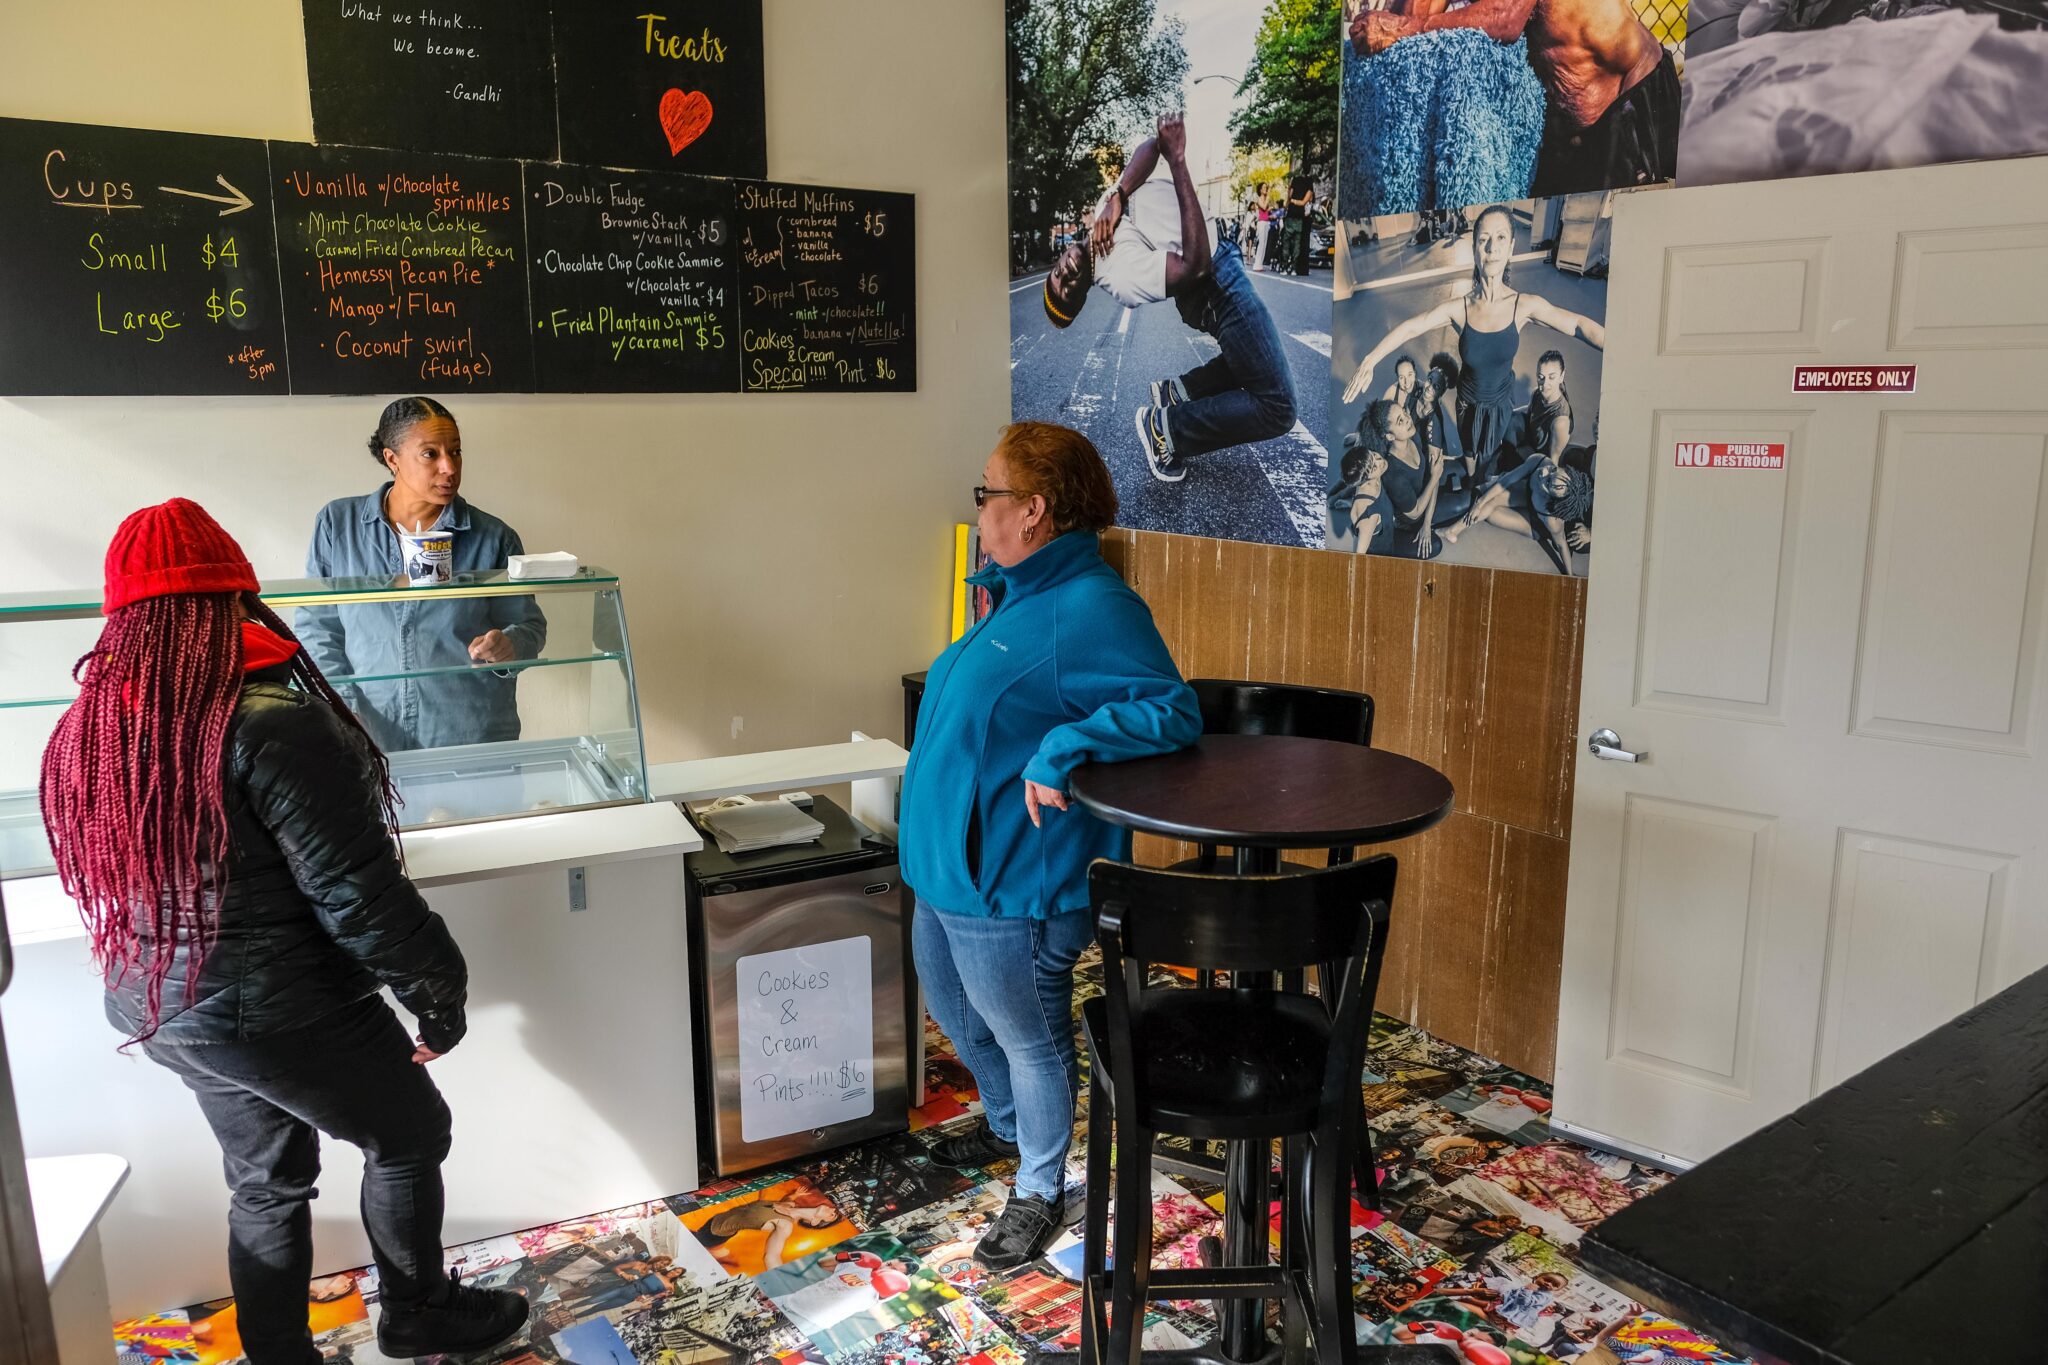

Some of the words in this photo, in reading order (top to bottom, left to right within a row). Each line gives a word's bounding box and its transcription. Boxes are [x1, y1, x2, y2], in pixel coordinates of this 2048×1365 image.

[341, 0, 381, 21] What
[393, 14, 414, 25] we
[427, 43, 480, 58] become.
[636, 13, 727, 63] Treats
[445, 83, 502, 102] -Gandhi
[44, 150, 134, 215] Cups
[294, 171, 368, 197] Vanilla
[434, 192, 510, 216] sprinkles
[544, 181, 603, 207] Double
[610, 183, 645, 214] Fudge
[744, 185, 797, 210] Stuffed
[804, 192, 855, 214] Muffins
[308, 211, 349, 236] Mint
[354, 212, 422, 233] Chocolate
[427, 211, 487, 233] Cookie
[601, 212, 650, 229] Brownie
[652, 212, 687, 230] Stack
[790, 216, 837, 226] cornbread
[864, 212, 886, 237] $5
[797, 230, 833, 239] banana
[798, 242, 829, 250] vanilla
[81, 233, 167, 271] Small
[202, 234, 239, 270] $4
[316, 239, 361, 259] Caramel
[365, 240, 397, 258] Fried
[401, 236, 465, 258] Cornbread
[471, 236, 514, 261] Pecan
[800, 252, 843, 261] chocolate
[544, 249, 604, 273] Chocolate
[608, 253, 632, 275] Chip
[636, 252, 674, 270] Cookie
[677, 252, 724, 268] Sammie
[319, 260, 394, 296] Hennessy
[400, 260, 447, 285] Pecan
[660, 295, 700, 307] vanilla
[753, 282, 794, 309] Dipped
[798, 280, 839, 301] Tacos
[858, 274, 879, 295] $6
[97, 291, 181, 342] Large
[207, 288, 246, 323] $6
[329, 296, 384, 326] Mango
[408, 292, 456, 317] Flan
[795, 306, 818, 320] mint
[552, 309, 594, 337] Fried
[599, 307, 660, 334] Plantain
[664, 311, 717, 329] Sammie
[804, 323, 842, 340] banana
[335, 330, 412, 358] Coconut
[425, 327, 473, 358] swirl
[696, 326, 725, 350] $5
[744, 328, 794, 352] Cookies
[238, 345, 265, 362] after
[788, 350, 795, 362] &
[798, 346, 835, 363] Cream
[249, 362, 275, 381] 5pm
[421, 352, 492, 384] (fudge)
[835, 359, 866, 383] Pint
[876, 357, 896, 380] $6
[1798, 371, 1872, 386] EMPLOYEES
[1877, 371, 1910, 386] ONLY
[1677, 444, 1710, 466] NO
[1713, 455, 1781, 467] RESTROOM
[1727, 445, 1769, 455] PUBLIC
[758, 970, 829, 996] Cookies
[780, 999, 798, 1024] &
[762, 1035, 818, 1057] Cream
[837, 1060, 864, 1089] $6
